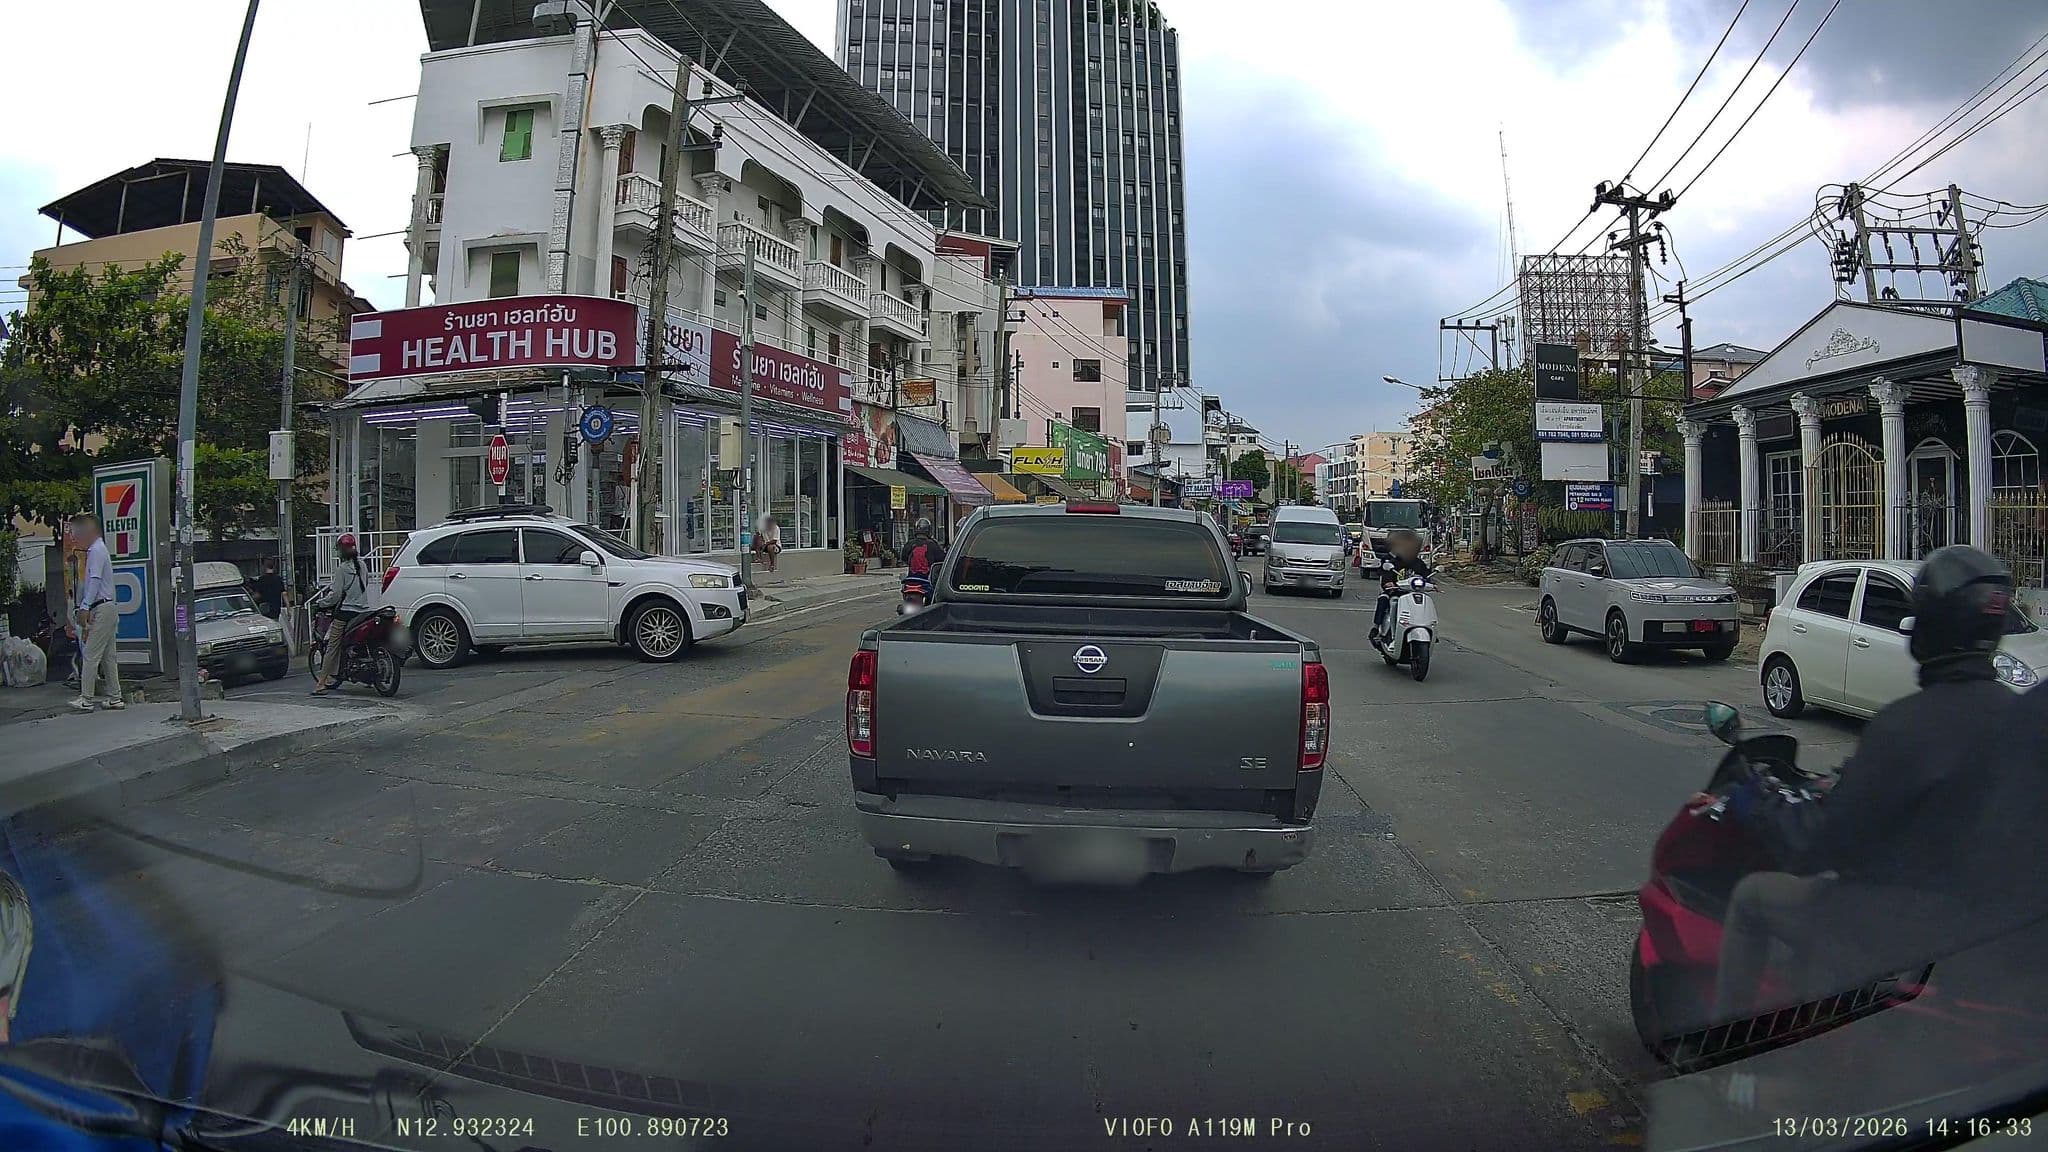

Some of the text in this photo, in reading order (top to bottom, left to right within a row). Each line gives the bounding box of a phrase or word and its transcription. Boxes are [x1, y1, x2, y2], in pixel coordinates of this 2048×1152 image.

[444, 303, 577, 331] ร้านยา เฮลท์ฮับ
[401, 327, 618, 370] HEALTH HUB
[731, 341, 776, 380] ร้นยา
[779, 361, 825, 392] เฮลท์ฮับ
[1537, 362, 1577, 373] MODENA
[769, 383, 795, 399] Vitamins
[801, 391, 825, 406] Wellness
[1823, 399, 1865, 418] MODENA
[491, 445, 507, 466] หยุด
[1095, 450, 1107, 474] 789
[492, 466, 505, 475] STOP
[1075, 655, 1105, 664] NISSAN
[906, 748, 988, 764] NAVARA
[1240, 756, 1267, 770] SE
